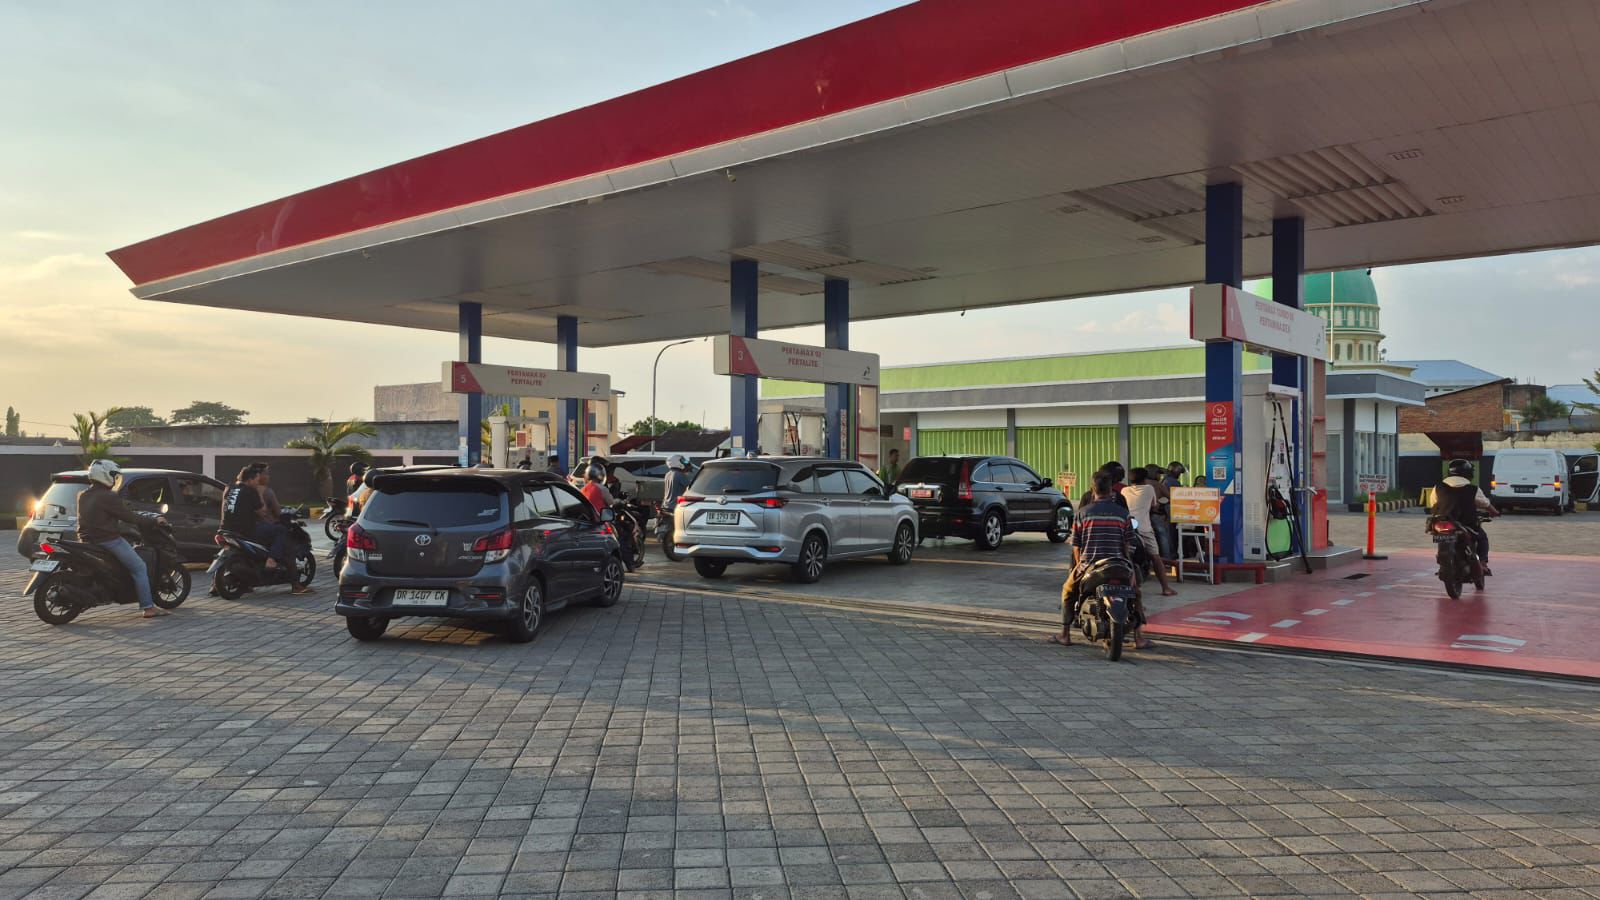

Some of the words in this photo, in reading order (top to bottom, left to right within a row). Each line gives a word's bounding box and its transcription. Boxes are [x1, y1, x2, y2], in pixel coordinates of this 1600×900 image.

[737, 350, 744, 360] 3
[460, 374, 467, 384] 5
[511, 378, 542, 386] PERTALITE
[396, 590, 407, 600] DR
[408, 590, 432, 600] 1407
[434, 591, 446, 600] CK
